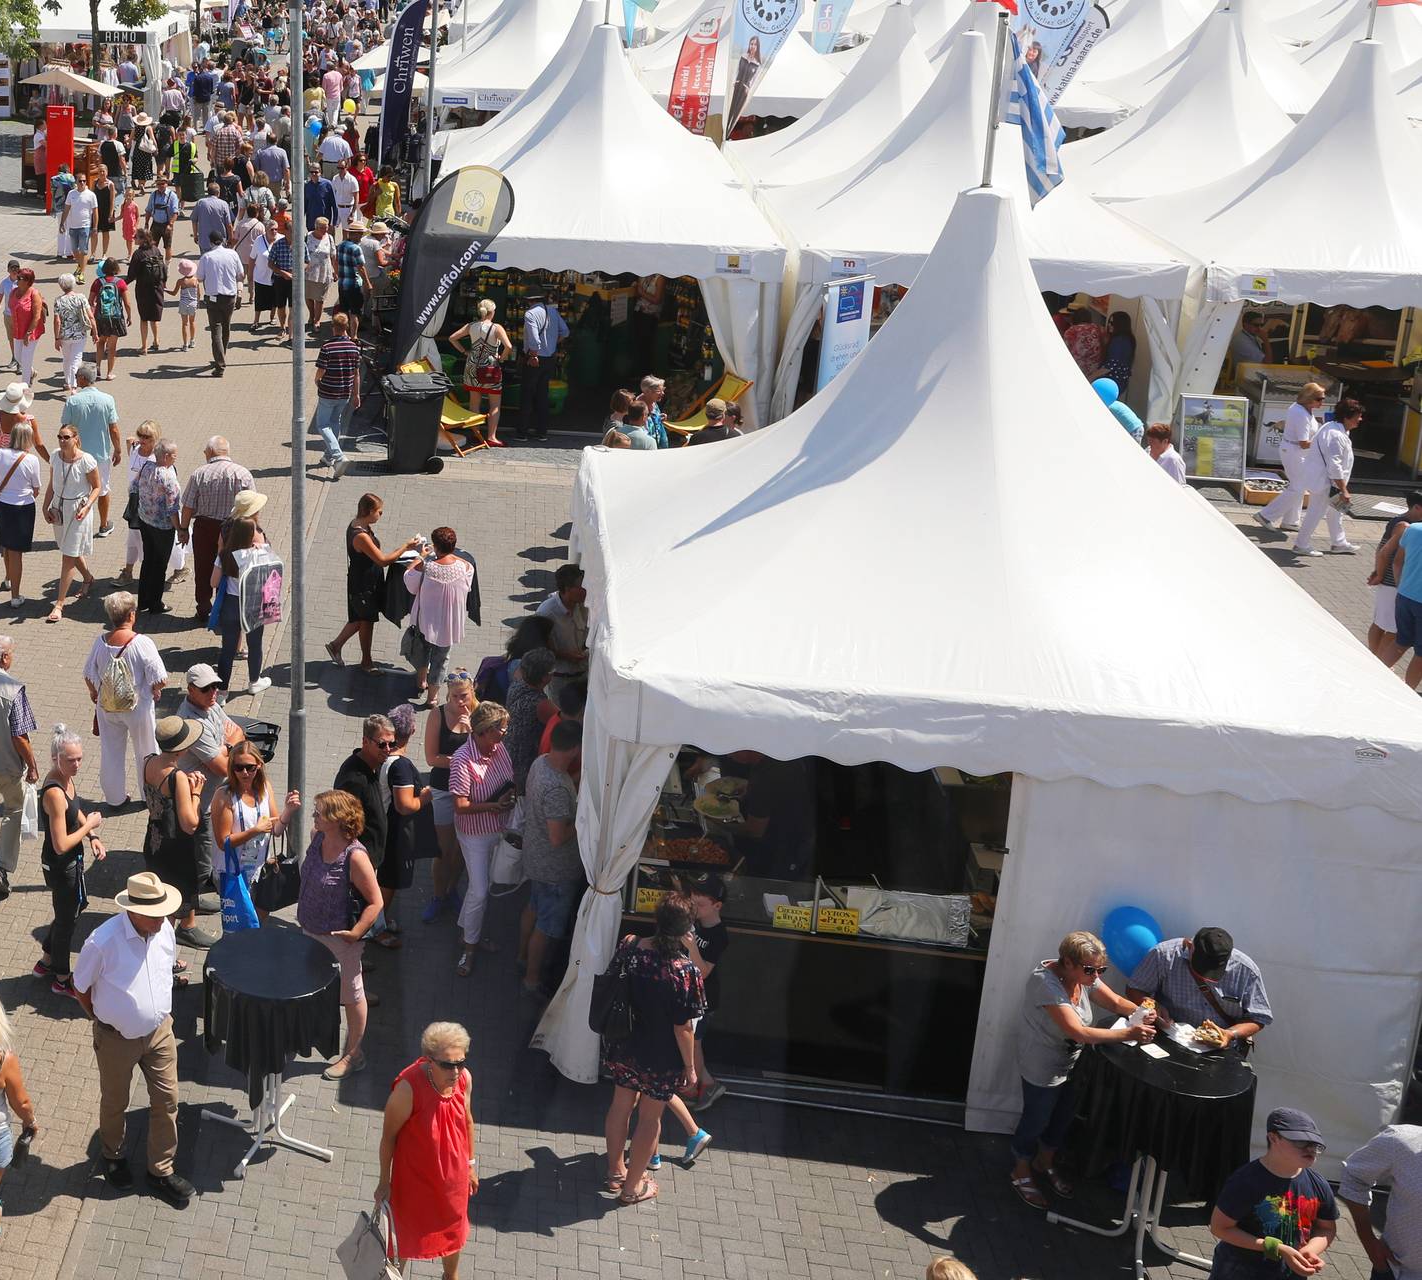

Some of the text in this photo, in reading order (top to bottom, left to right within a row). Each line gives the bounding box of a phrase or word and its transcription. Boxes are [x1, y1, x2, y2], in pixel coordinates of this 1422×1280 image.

[393, 26, 415, 94] Chriwen
[1049, 28, 1103, 106] ww.katina-kaarst.de
[478, 93, 512, 103] Chriwen
[453, 210, 485, 227] Effol
[416, 239, 482, 326] www.effol.com
